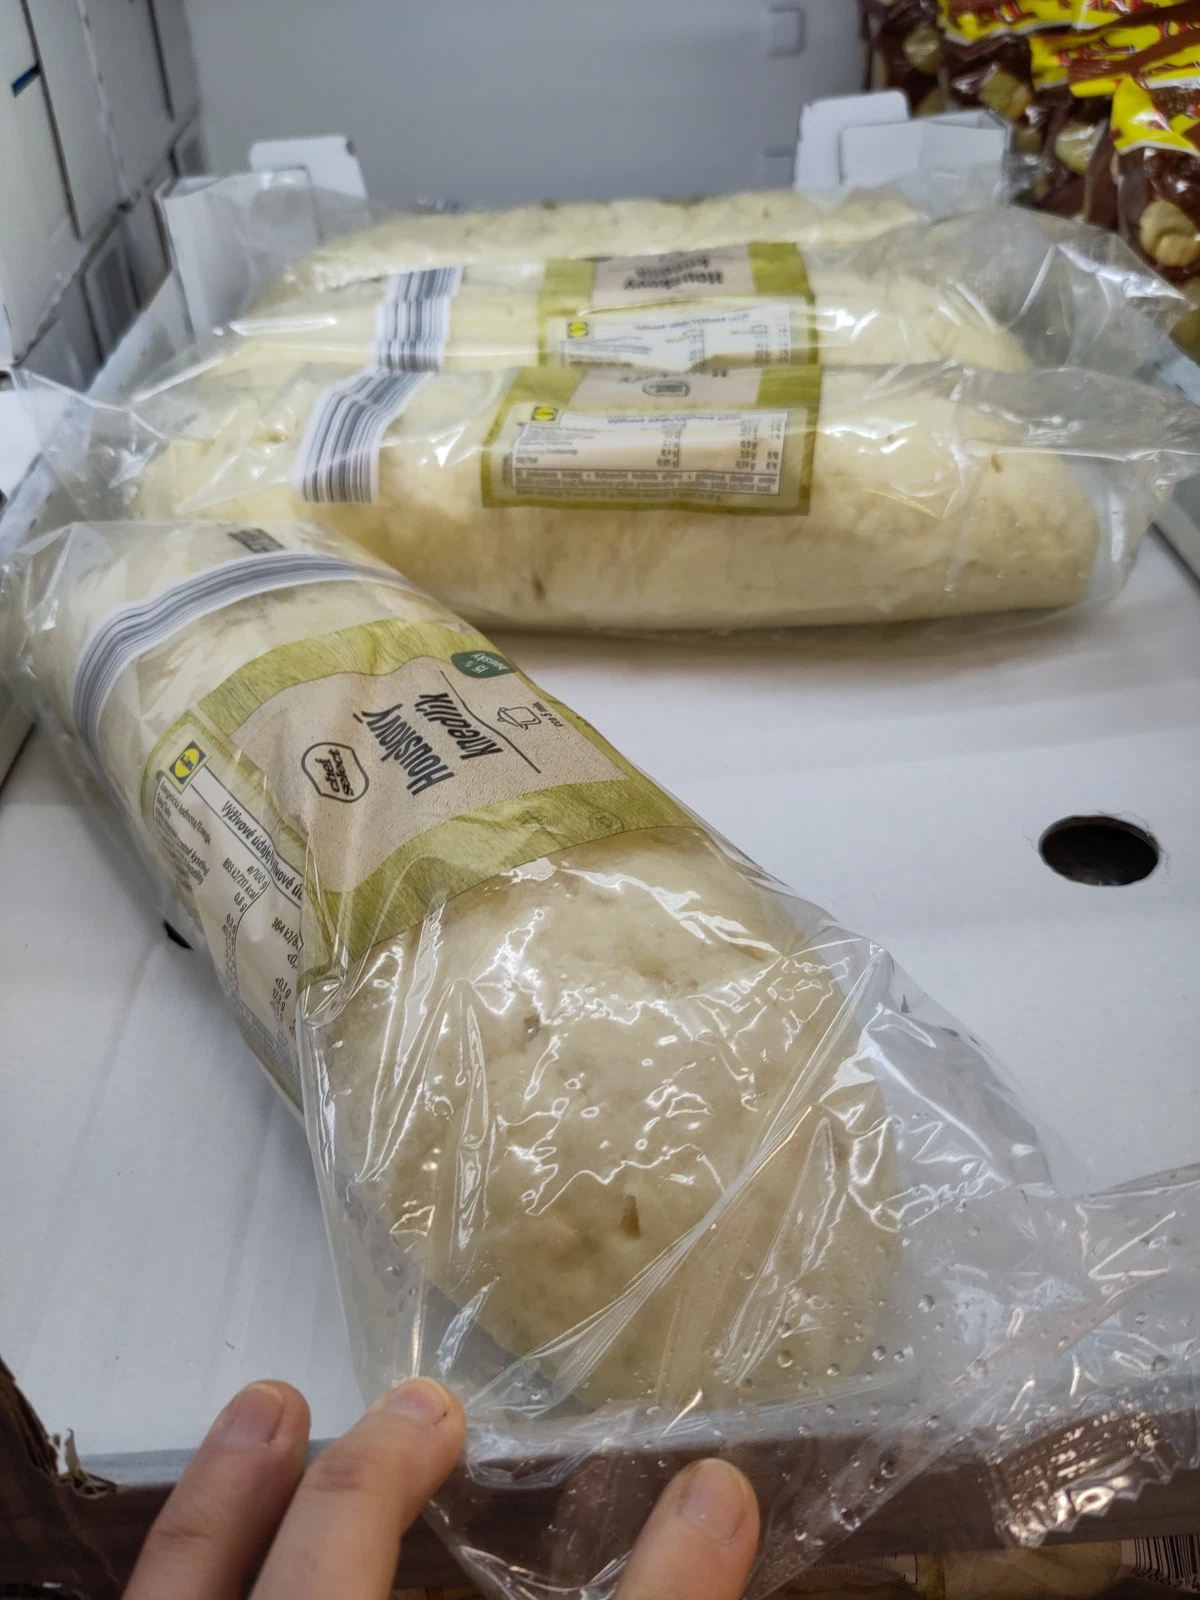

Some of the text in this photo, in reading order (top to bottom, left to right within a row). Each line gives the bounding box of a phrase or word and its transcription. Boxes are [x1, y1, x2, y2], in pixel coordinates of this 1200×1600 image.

[414, 692, 504, 760] knedlík
[353, 703, 455, 796] Houskový
[315, 757, 341, 793] chef
[328, 748, 355, 797] select
[221, 800, 257, 839] Výživové
[244, 883, 260, 900] kcal
[271, 916, 286, 935] 364
